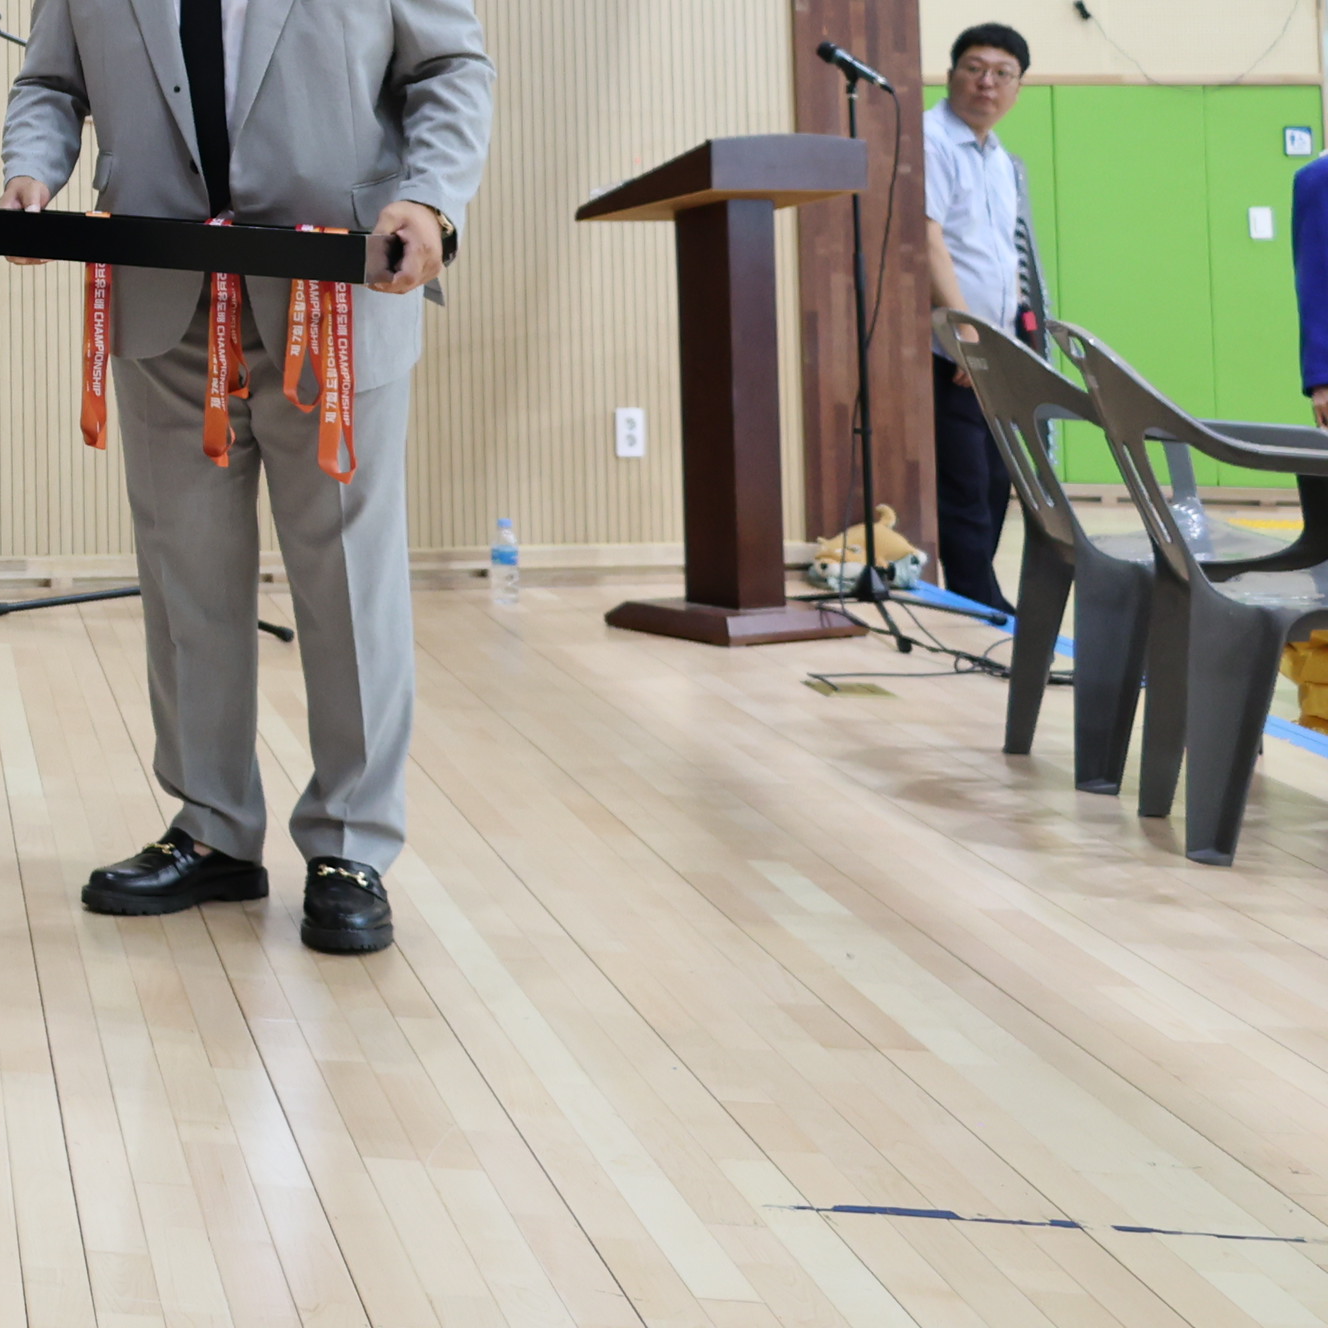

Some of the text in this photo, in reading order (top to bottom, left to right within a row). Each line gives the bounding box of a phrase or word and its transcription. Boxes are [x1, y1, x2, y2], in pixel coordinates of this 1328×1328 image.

[292, 325, 304, 342] 7회
[92, 312, 105, 396] CHAMPIONSHIP
[290, 344, 301, 357] 제
[337, 338, 351, 426] CHAMPIONSHIP
[325, 391, 337, 409] 7회
[325, 411, 337, 423] 제
